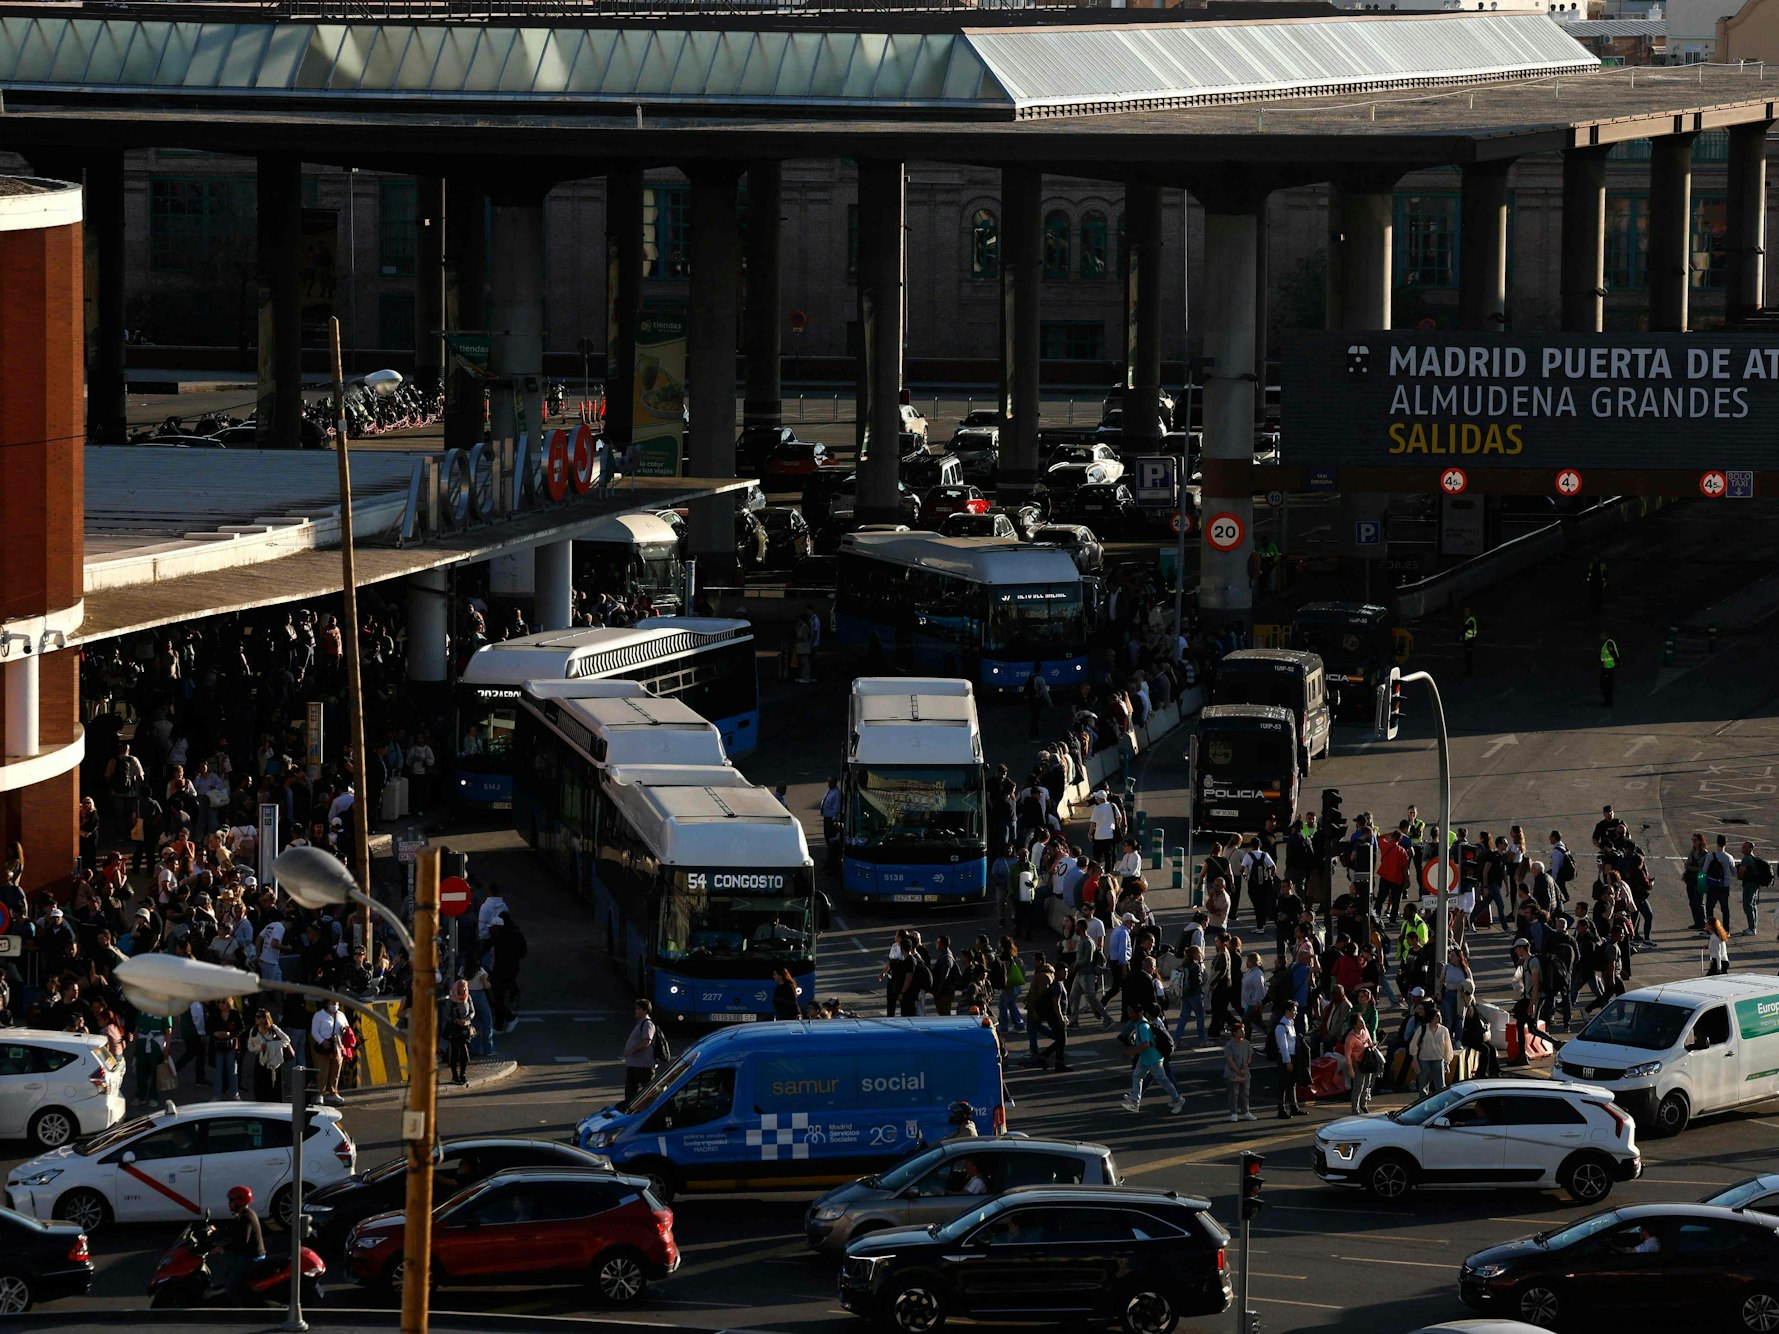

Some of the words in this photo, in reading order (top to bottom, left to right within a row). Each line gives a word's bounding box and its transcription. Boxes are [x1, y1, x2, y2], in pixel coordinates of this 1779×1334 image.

[1389, 346, 1527, 378] MADRID
[1542, 347, 1672, 379] PUERTA
[1688, 349, 1730, 379] DE
[1389, 385, 1577, 417] ALMUDENA
[1591, 387, 1749, 419] GRANDES
[1388, 422, 1524, 455] SALIDAS
[1728, 472, 1751, 480] SOLO
[1214, 525, 1236, 539] 20
[1360, 523, 1376, 542] P
[1325, 673, 1350, 682] ICIA
[1203, 789, 1265, 799] POLICIA
[687, 873, 707, 889] 54
[713, 874, 783, 888] CONGOSTO
[702, 993, 723, 1001] 2277
[1582, 1066, 1596, 1079] FIAT
[772, 1079, 839, 1096] samur
[861, 1071, 925, 1092] social
[828, 1123, 853, 1131] Madrid
[829, 1129, 861, 1137] Servicios
